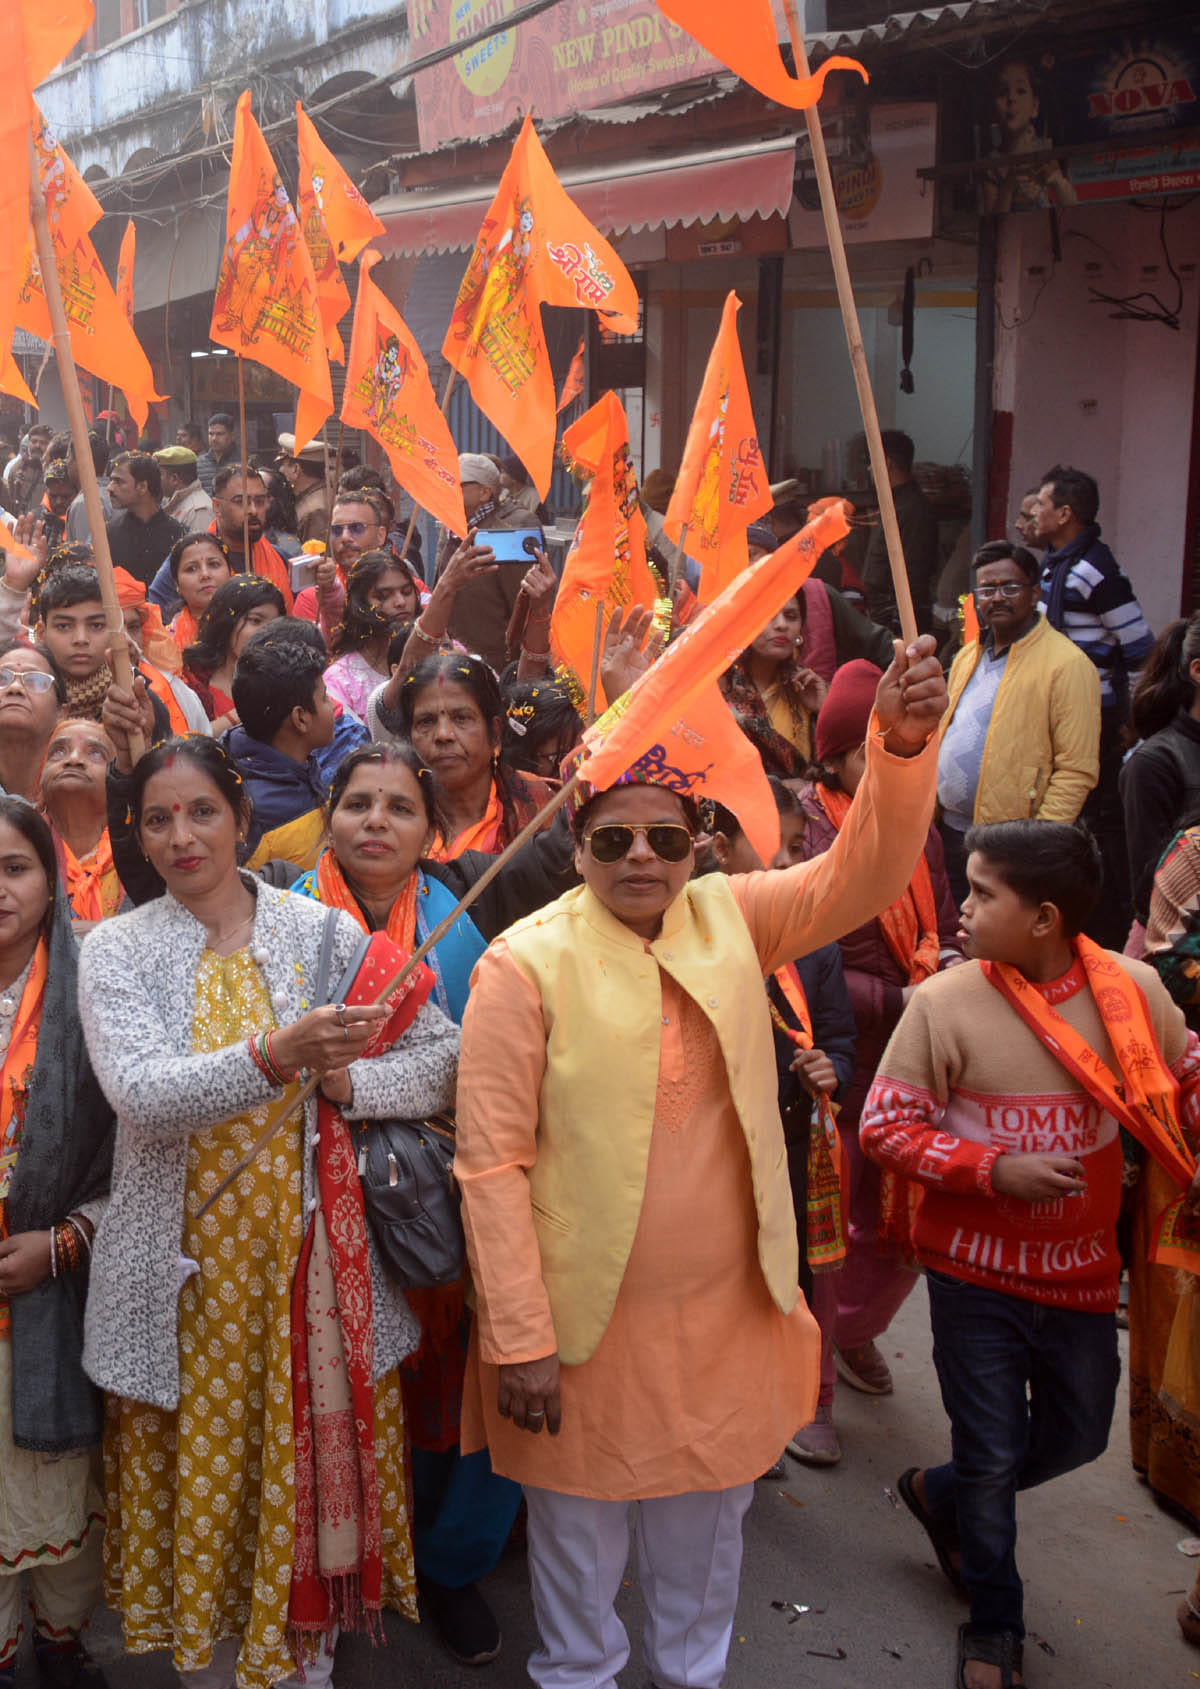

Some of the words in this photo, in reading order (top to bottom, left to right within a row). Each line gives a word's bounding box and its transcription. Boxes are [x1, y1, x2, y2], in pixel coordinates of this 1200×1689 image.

[465, 31, 508, 77] SWEETS
[552, 33, 596, 73] NEW
[601, 12, 664, 57] PINDI
[1088, 80, 1197, 118] NOVA
[546, 241, 582, 278] श्री
[574, 269, 608, 306] राम
